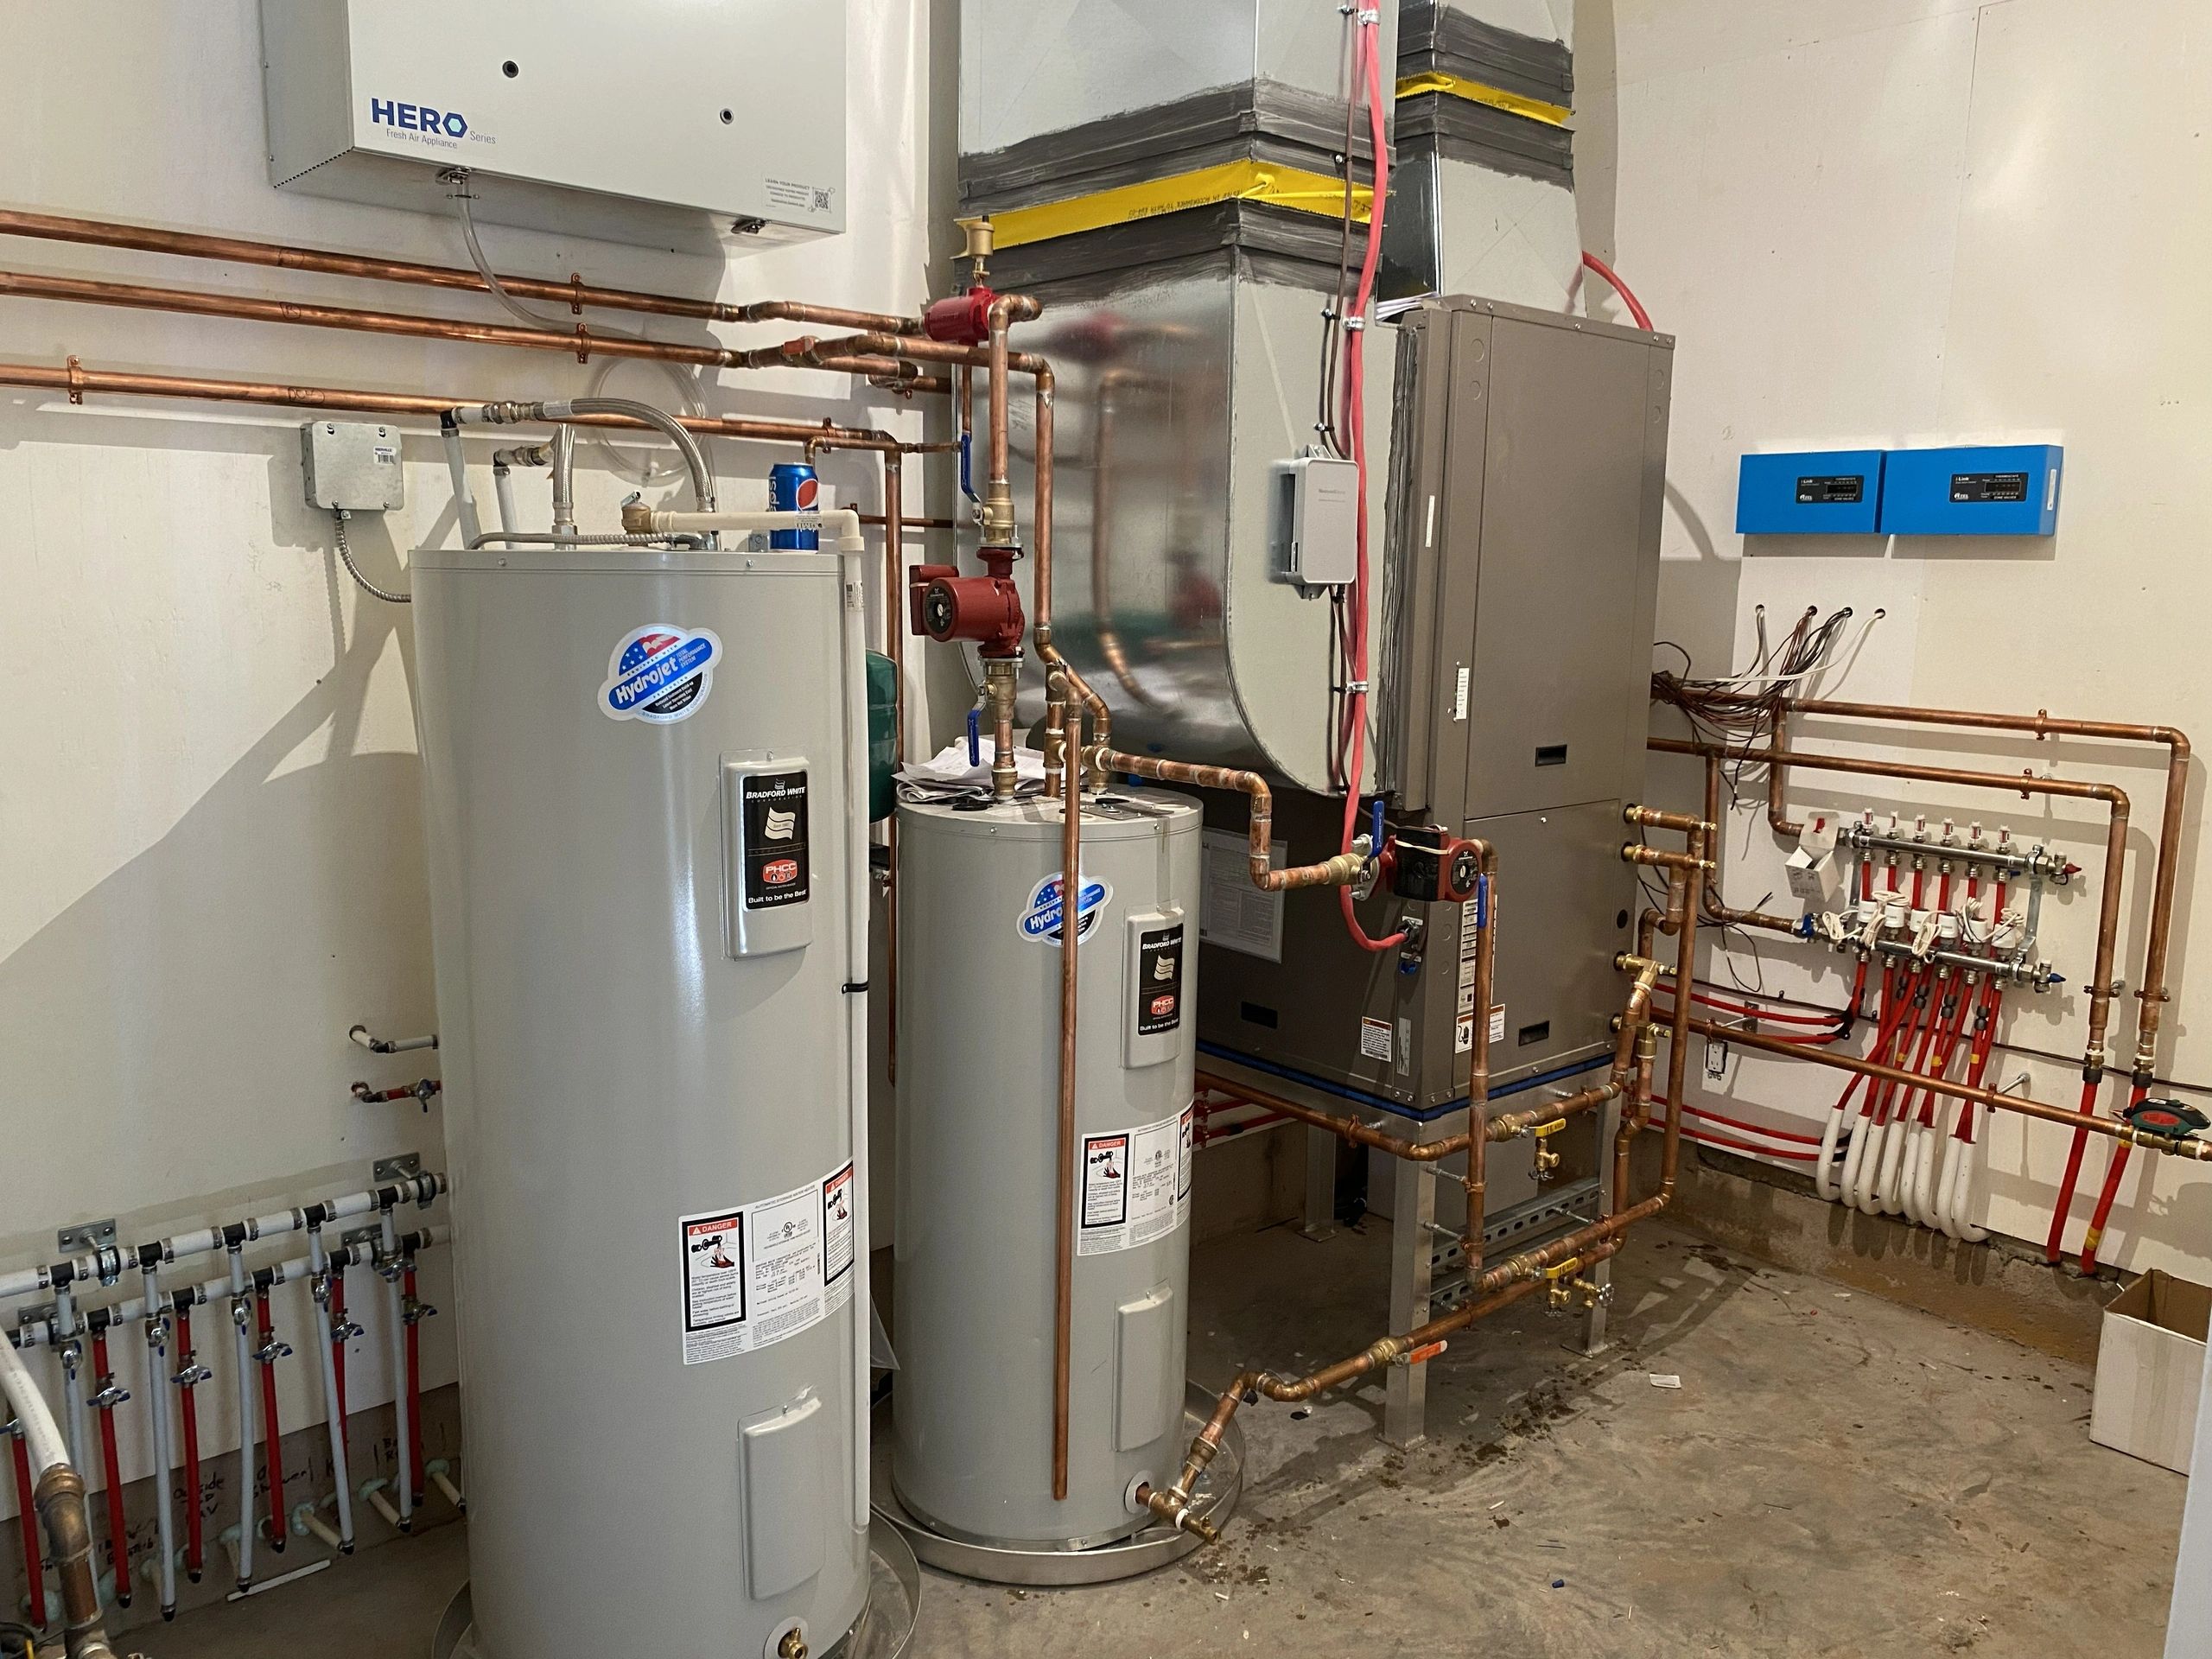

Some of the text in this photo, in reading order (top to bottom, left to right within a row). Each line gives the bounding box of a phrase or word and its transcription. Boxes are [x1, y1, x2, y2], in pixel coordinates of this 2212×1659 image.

[372, 98, 496, 144] HERO Series
[386, 129, 458, 149] Fresh Air Appliance
[615, 656, 679, 704] Hydrojet
[746, 786, 806, 799] BRADFORD WHITE
[765, 863, 797, 874] PHCC
[748, 895, 764, 904] Built
[1030, 906, 1063, 930] Hydro
[1142, 940, 1170, 950] BRADFORD
[1153, 998, 1173, 1008] PHCC
[702, 1221, 732, 1233] DANGER
